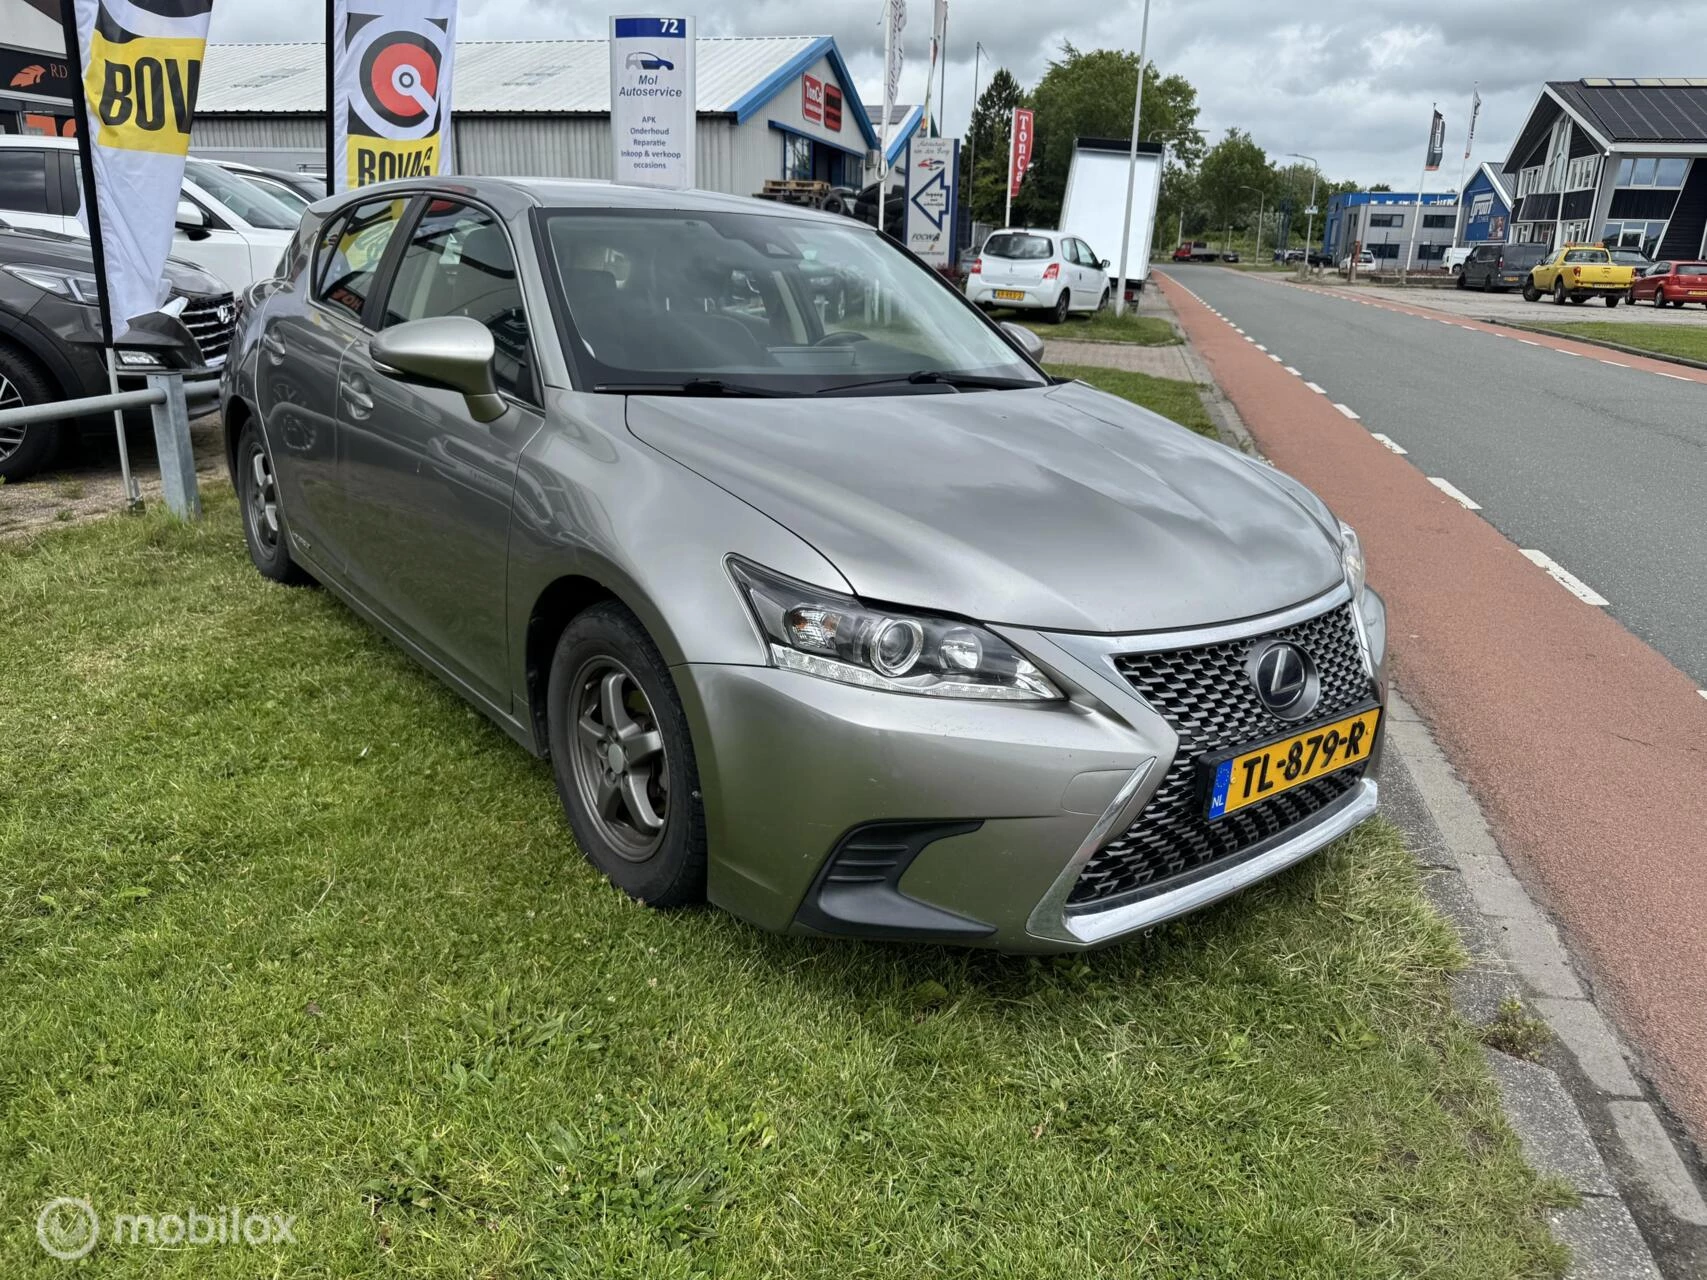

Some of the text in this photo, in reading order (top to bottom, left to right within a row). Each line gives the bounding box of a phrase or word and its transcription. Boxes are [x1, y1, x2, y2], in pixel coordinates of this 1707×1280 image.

[660, 19, 679, 33] 72
[638, 75, 658, 85] Mol
[619, 86, 682, 97] Autoservice
[642, 116, 656, 124] APK
[630, 127, 669, 135] Onderhoud
[633, 138, 666, 148] Reparatie
[1016, 114, 1029, 183] TonCa
[652, 151, 681, 160] verkoop
[358, 146, 433, 187] BOVAG
[1243, 720, 1366, 798] TL-879-R
[1212, 795, 1224, 808] NL
